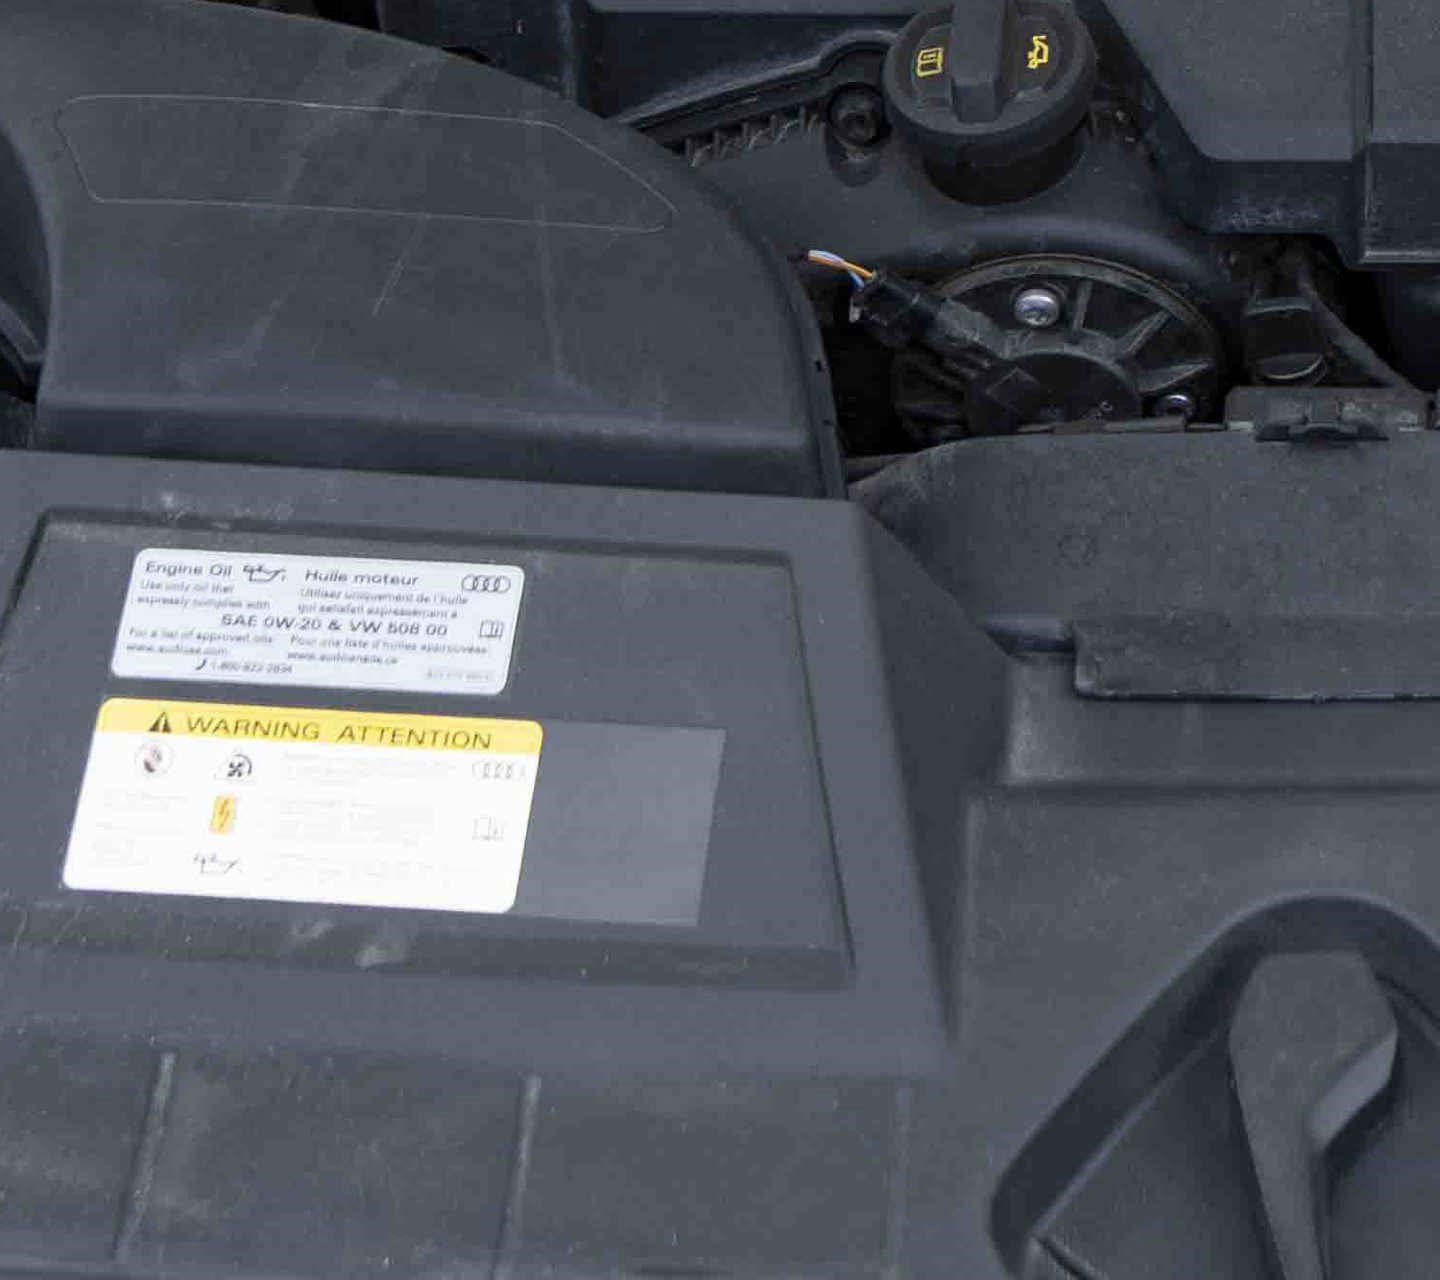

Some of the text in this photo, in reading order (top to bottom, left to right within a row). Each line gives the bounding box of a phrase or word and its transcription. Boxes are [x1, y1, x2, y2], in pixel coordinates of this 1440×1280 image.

[145, 561, 233, 577] Engine Oil
[305, 569, 419, 585] Huile moteur
[221, 614, 258, 628] SAE
[265, 617, 321, 631] 0W-20
[328, 619, 341, 631] &
[349, 621, 382, 633] VW
[426, 623, 448, 636] 00
[186, 716, 492, 750] WARNING ATTENTION
